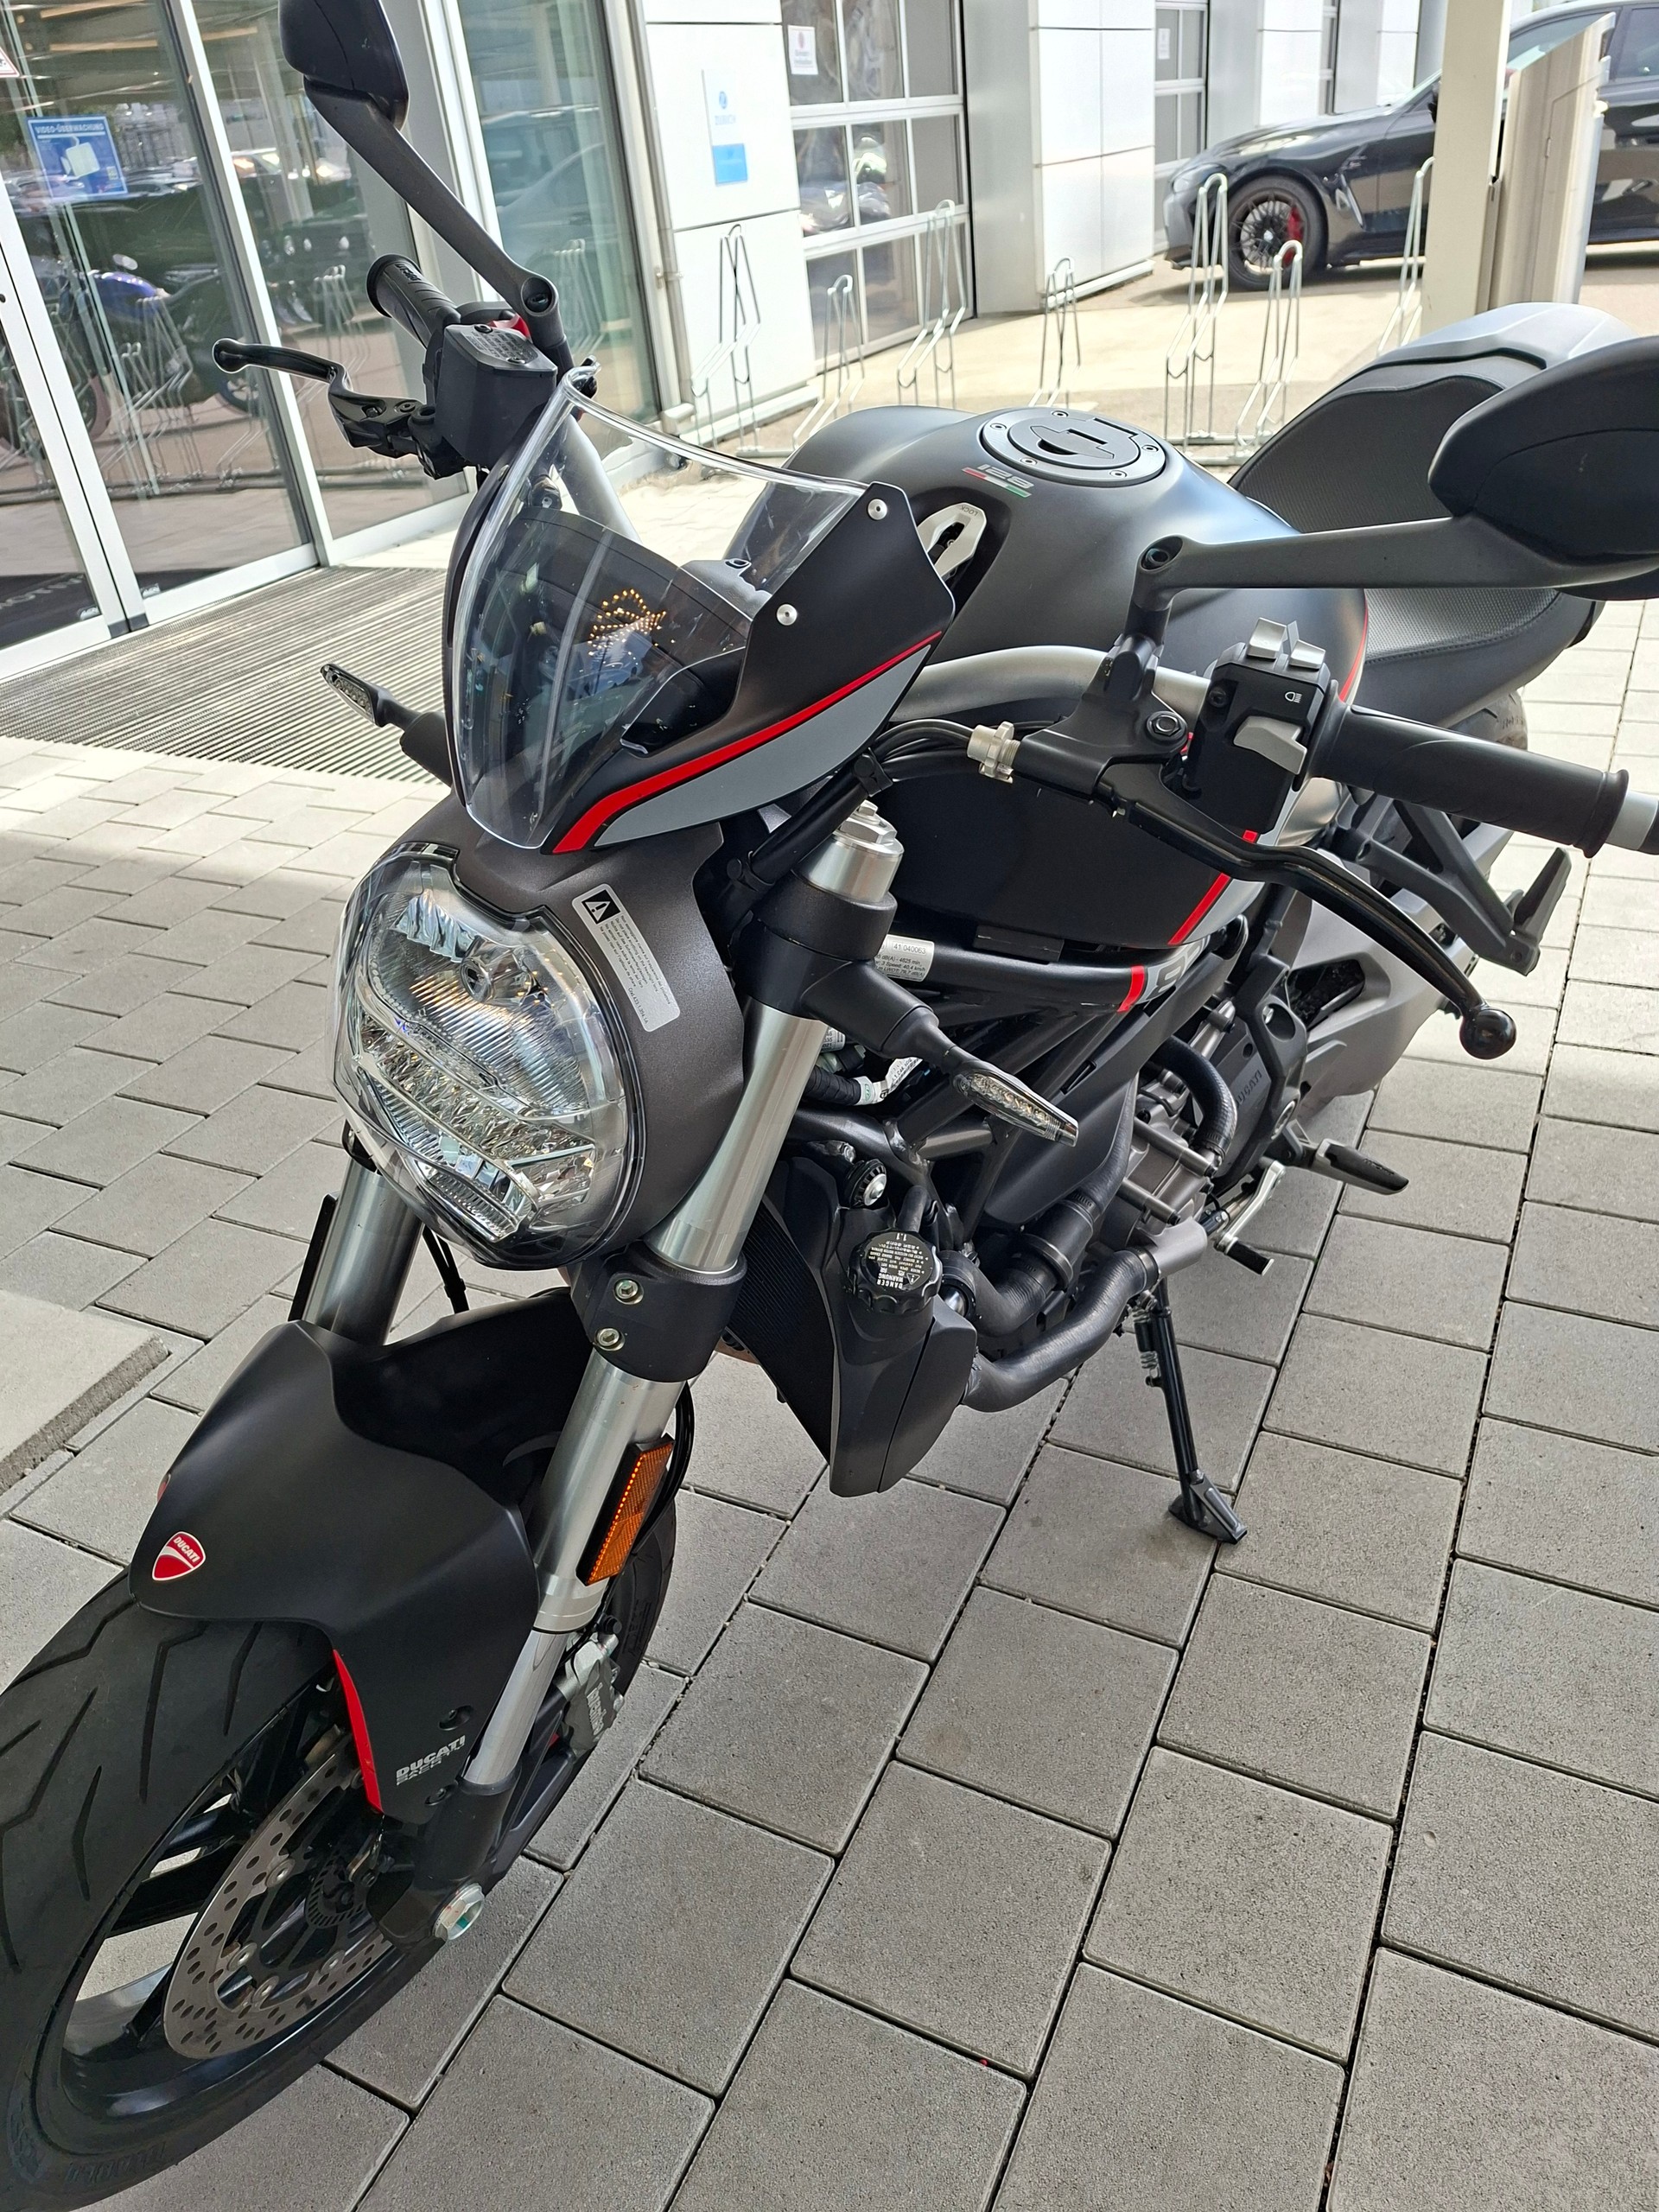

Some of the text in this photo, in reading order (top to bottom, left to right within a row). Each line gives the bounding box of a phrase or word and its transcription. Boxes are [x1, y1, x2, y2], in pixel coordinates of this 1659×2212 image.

[976, 463, 1035, 489] 821
[960, 505, 978, 517] LOCK
[877, 1279, 903, 1288] DANGER
[878, 1273, 903, 1281] WARNUNG
[173, 1536, 200, 1563] DUCATI
[586, 1682, 607, 1736] brembo
[397, 1735, 466, 1778] DUCATI
